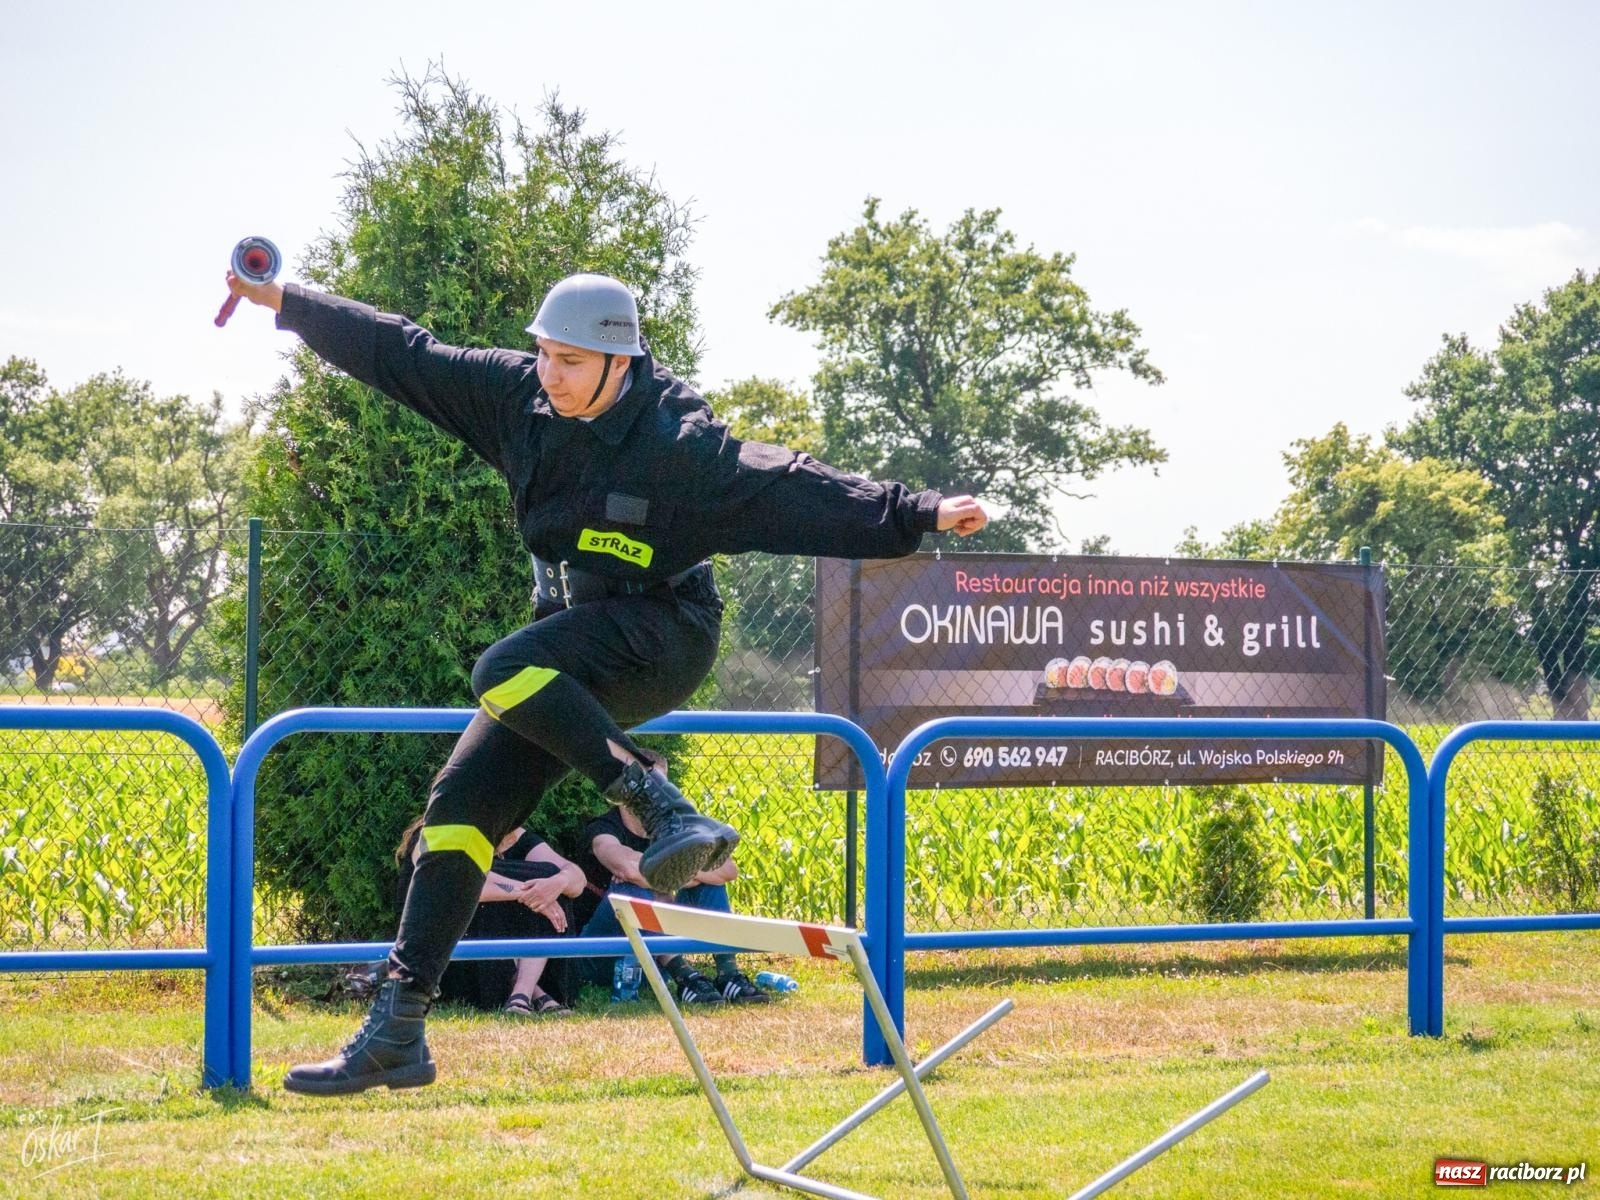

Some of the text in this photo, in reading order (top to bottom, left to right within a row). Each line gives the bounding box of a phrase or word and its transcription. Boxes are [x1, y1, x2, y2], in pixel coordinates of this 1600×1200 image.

[955, 571, 1266, 603] Restauracja inna niż wszystkie
[900, 603, 1321, 657] OKINAWA sushi & grill
[963, 746, 994, 768] 690
[998, 746, 1032, 768] 562
[1035, 746, 1068, 767] 947
[1095, 744, 1175, 768] RACIBÓRZ,
[1178, 749, 1196, 766] ul.
[1199, 750, 1252, 769] Wojska
[1256, 750, 1323, 767] Polskiego
[1327, 750, 1344, 765] 9h
